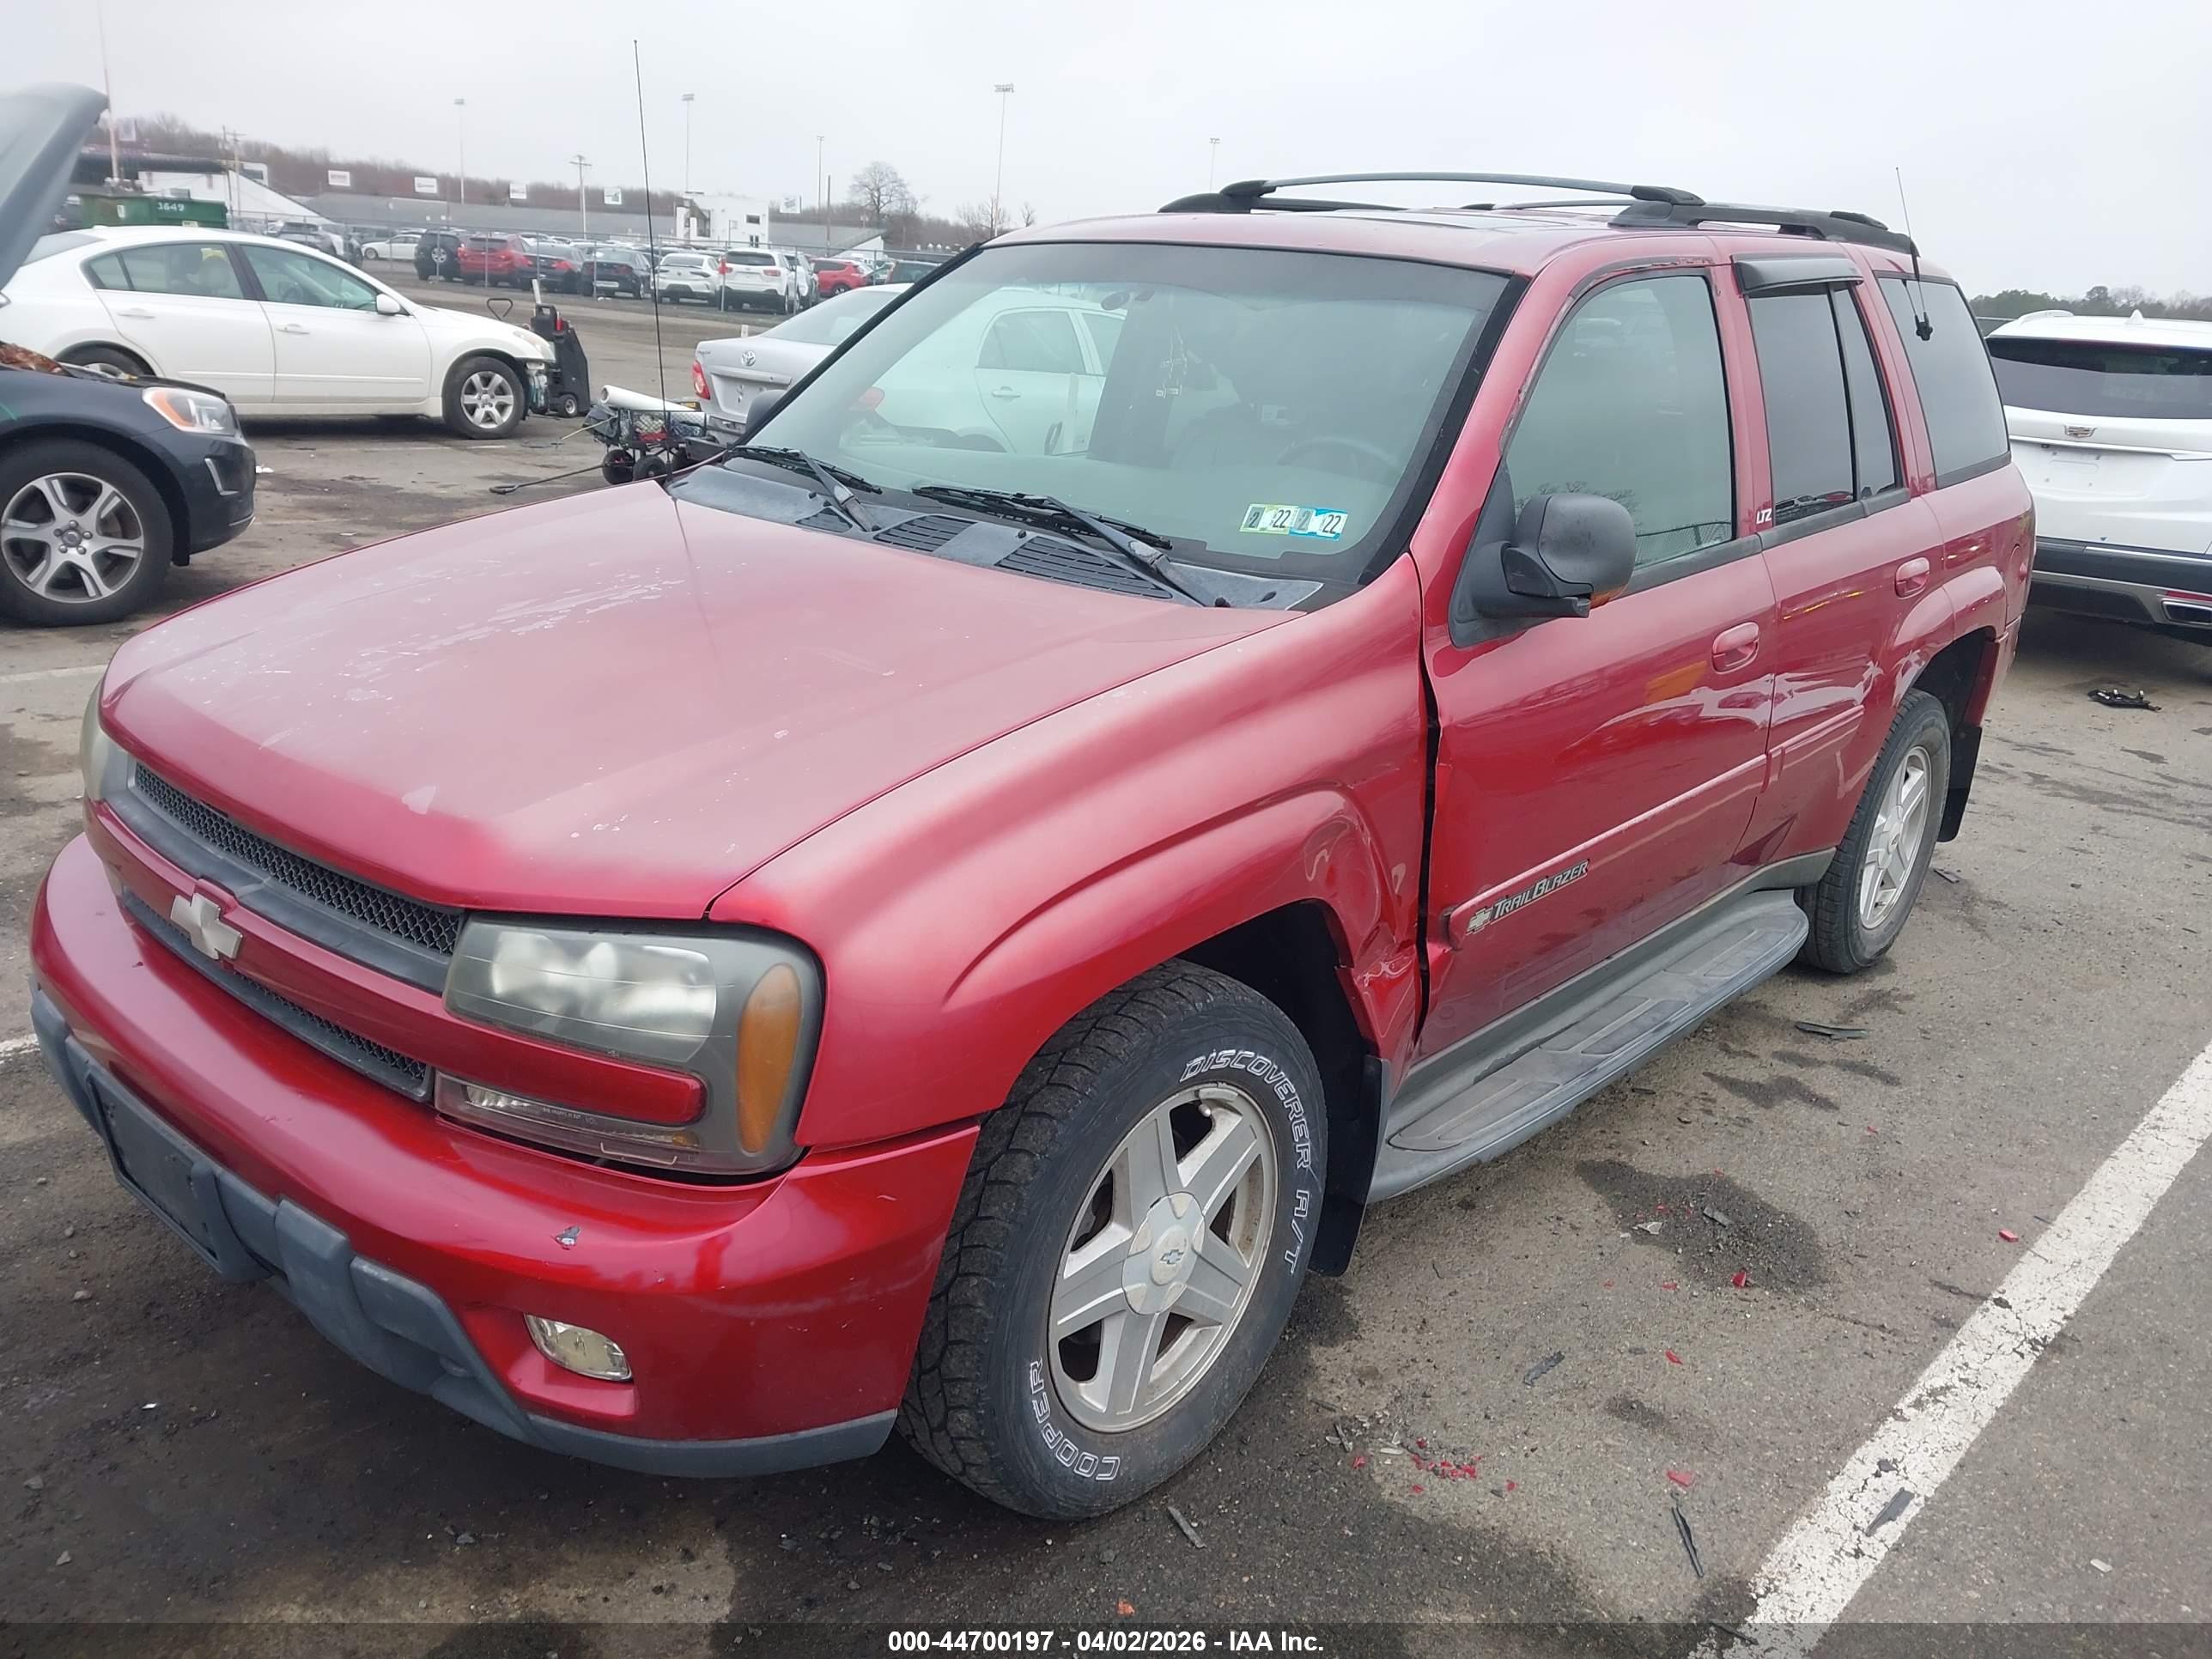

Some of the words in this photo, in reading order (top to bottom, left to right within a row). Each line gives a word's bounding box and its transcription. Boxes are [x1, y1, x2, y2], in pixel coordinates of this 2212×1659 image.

[1272, 509, 1291, 529] 22
[1322, 514, 1341, 534] 22
[1756, 508, 1772, 525] LTZ
[1179, 1048, 1311, 1170] DISCOVERER
[1284, 1188, 1310, 1274] A/T
[1030, 1356, 1121, 1481] COOPER
